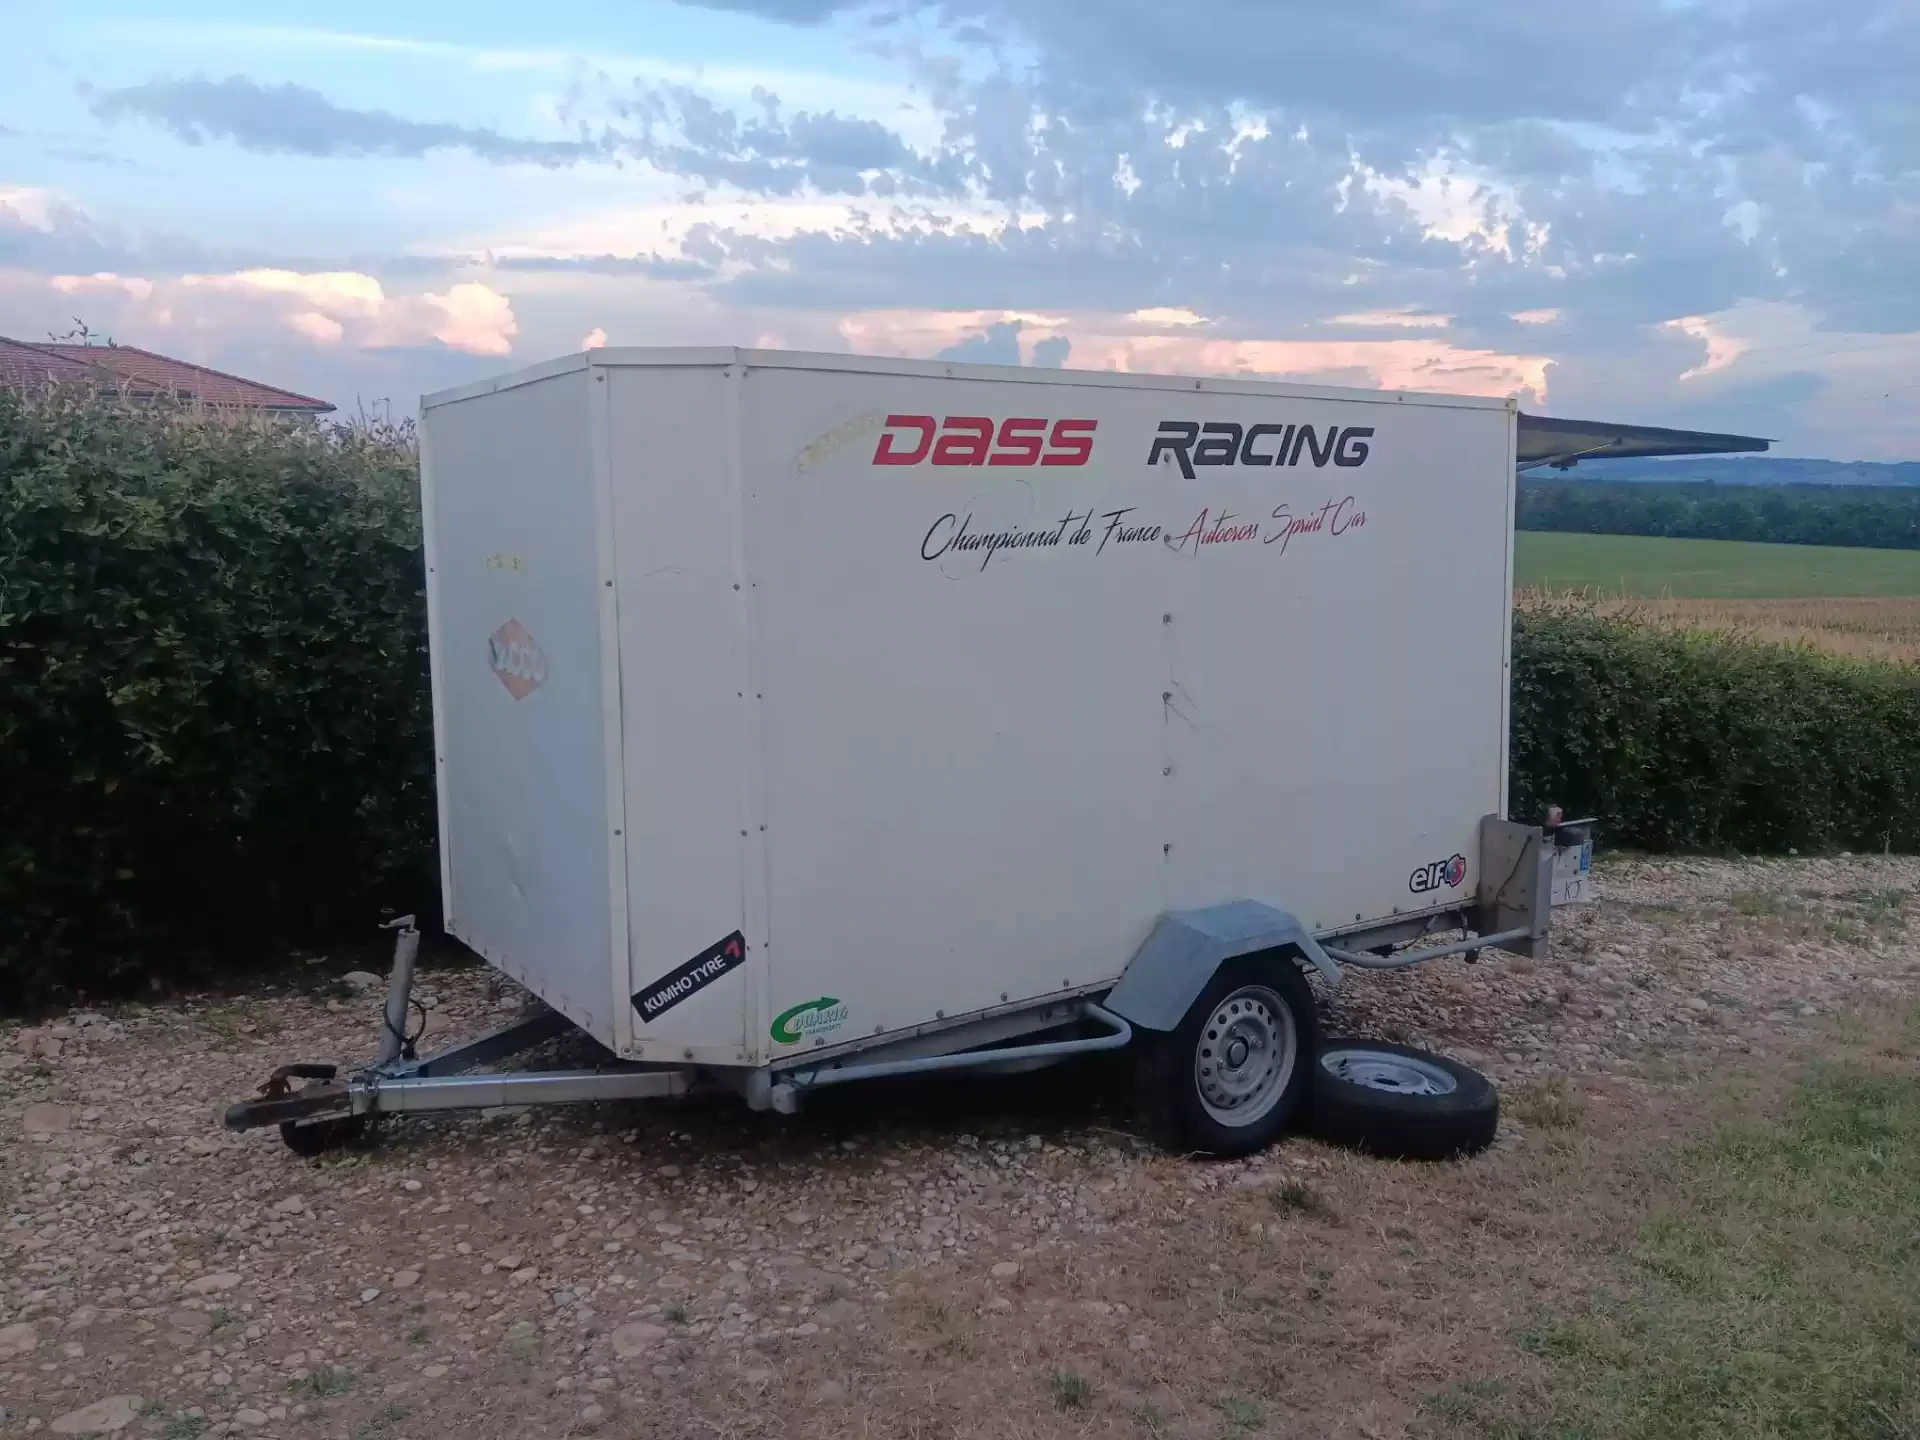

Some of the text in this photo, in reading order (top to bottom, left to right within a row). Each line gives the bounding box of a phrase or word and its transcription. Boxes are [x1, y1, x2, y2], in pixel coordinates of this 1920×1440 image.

[920, 509, 1071, 572] Championnat
[1067, 508, 1093, 547] de
[1096, 507, 1162, 557] France
[1263, 497, 1333, 557] Sprint
[1330, 496, 1369, 537] Car
[1409, 861, 1447, 893] elf
[643, 955, 726, 1012] KUMHO TYRE
